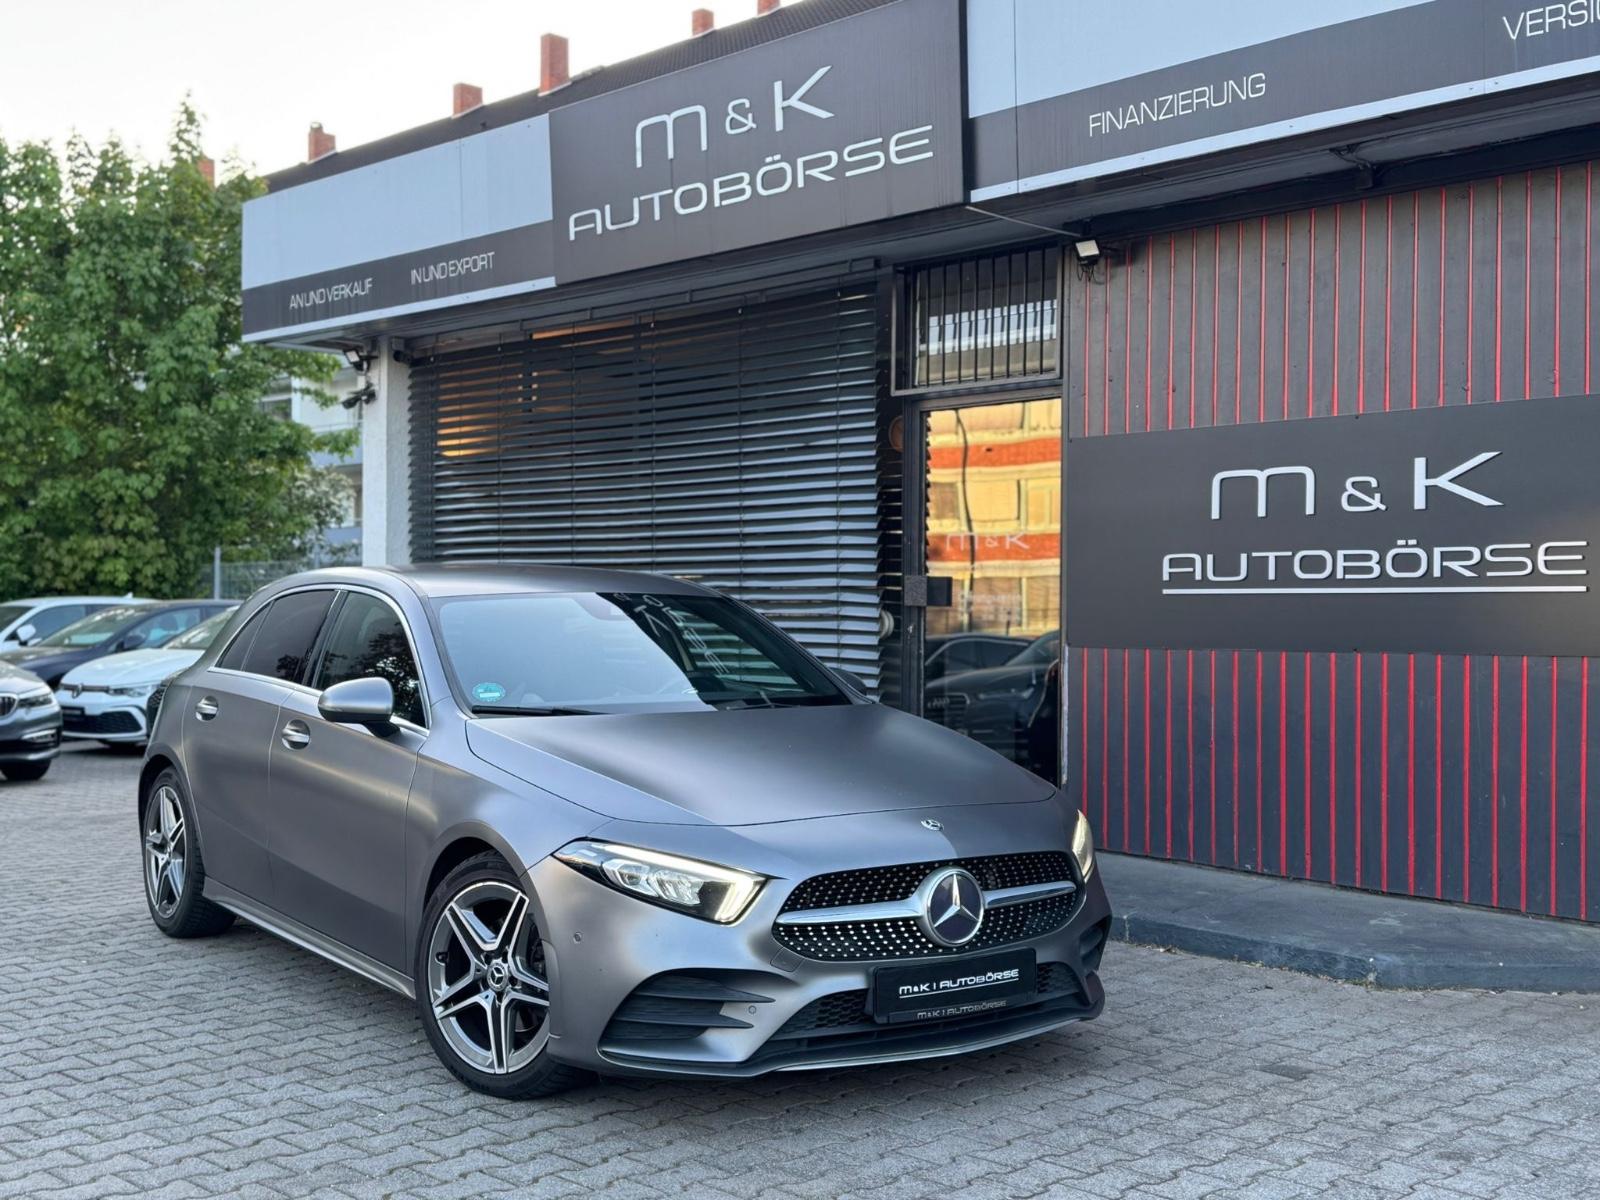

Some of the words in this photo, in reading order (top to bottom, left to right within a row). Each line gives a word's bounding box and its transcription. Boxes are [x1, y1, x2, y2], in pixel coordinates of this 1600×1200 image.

[635, 104, 707, 169] M
[725, 98, 757, 135] &
[774, 65, 835, 132] K
[1088, 72, 1266, 138] FINANZIERUNG
[568, 124, 934, 241] AUTOBÖRSE
[410, 268, 422, 286] IN
[422, 262, 448, 283] UND
[448, 251, 496, 277] EXPORT
[289, 293, 304, 310] AN
[304, 287, 326, 307] UND
[326, 277, 374, 303] VERKAUF
[1211, 465, 1315, 520] M
[1340, 475, 1388, 512] &
[1413, 451, 1504, 510] K
[1005, 531, 1030, 550] K
[1162, 539, 1588, 582] AUTOBÖRSE
[939, 968, 1019, 989] AUTOBÖRSE
